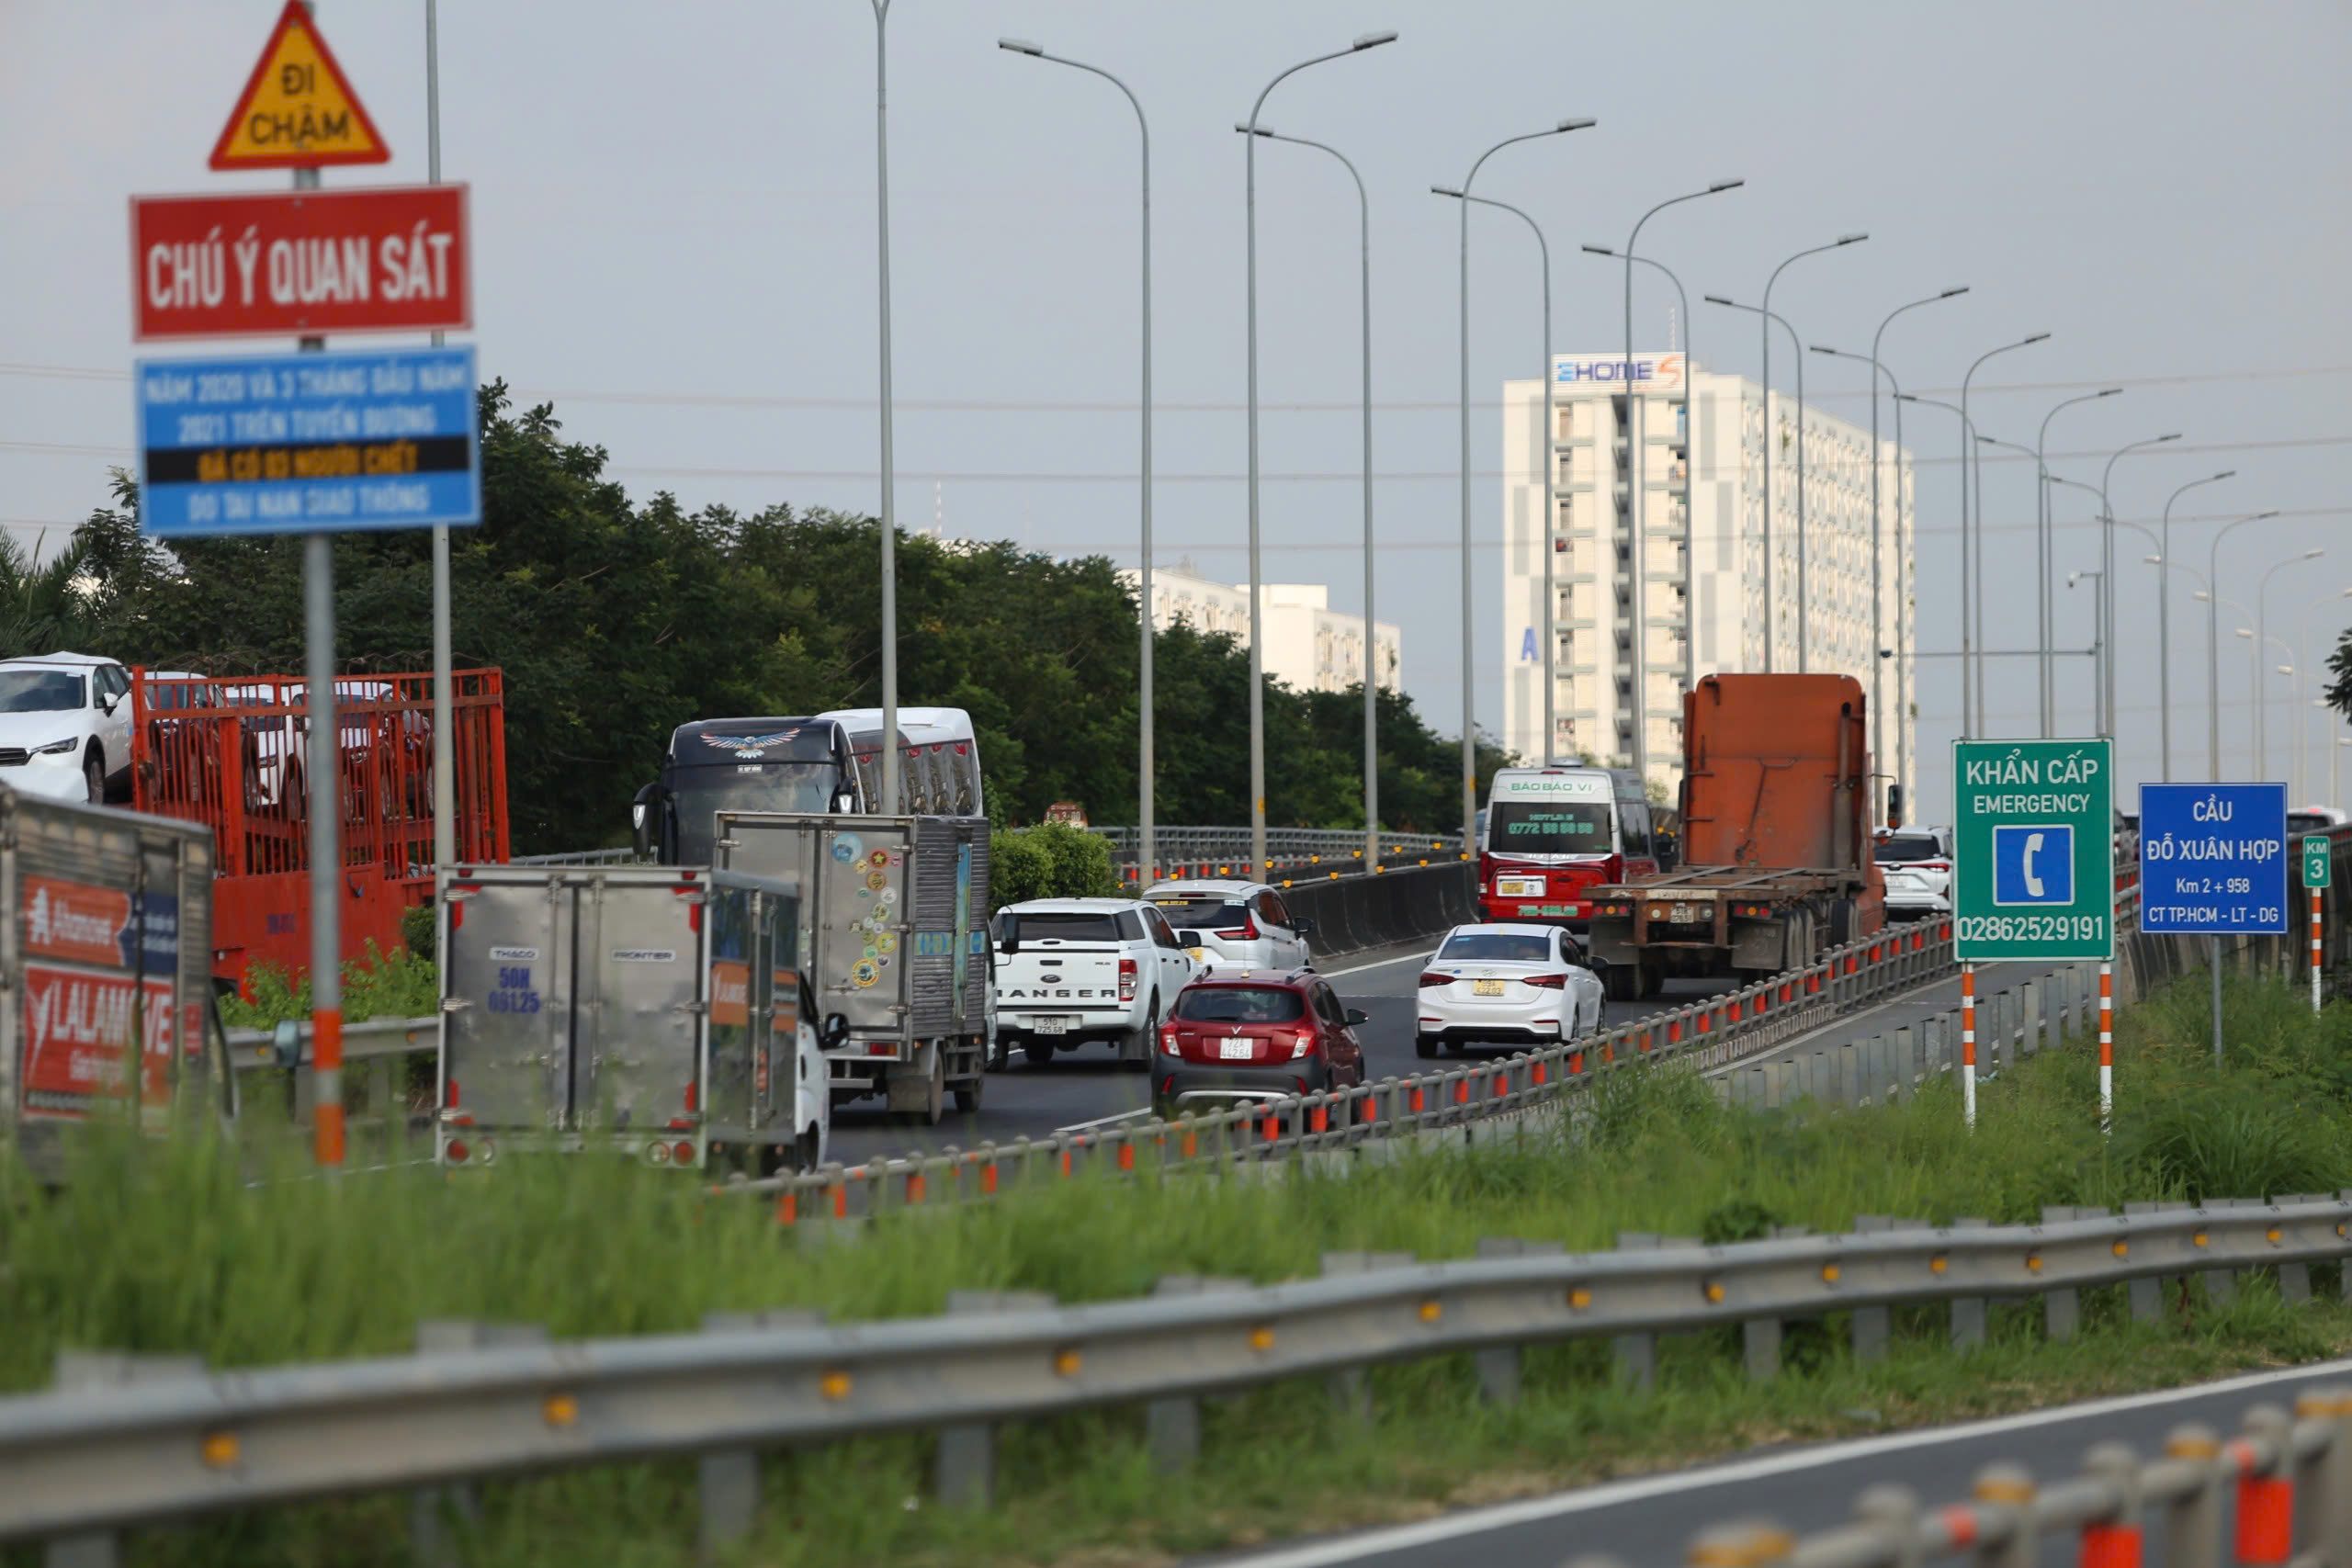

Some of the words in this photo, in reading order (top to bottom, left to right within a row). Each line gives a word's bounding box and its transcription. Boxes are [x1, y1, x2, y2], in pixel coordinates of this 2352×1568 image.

[281, 63, 315, 96] ĐI
[148, 225, 224, 310] CHÚ
[234, 225, 259, 306] Ý
[269, 236, 369, 304] QUAN
[380, 219, 453, 300] SÁT
[1521, 626, 1539, 661] A
[1966, 749, 2039, 785] KHẨN
[2047, 750, 2098, 784] CẤP
[1973, 793, 2090, 814] EMERGENCY
[2193, 793, 2233, 822] CẦU
[2146, 832, 2175, 861] ĐỖ
[2178, 836, 2233, 861] XUÂN
[2239, 837, 2280, 864] HỢP
[2307, 842, 2327, 853] KM
[2311, 859, 2324, 879] 3
[2176, 877, 2199, 894] Km
[2202, 878, 2211, 894] 2
[2214, 882, 2223, 893] +
[2226, 877, 2250, 894] 958
[2148, 907, 2166, 923] CT
[2168, 907, 2218, 923] TP.HCM
[2231, 907, 2247, 923] LT
[2258, 907, 2279, 923] DG
[1958, 915, 2104, 942] 02862529191
[492, 949, 537, 959] THACO
[613, 952, 673, 960] FRONTIER
